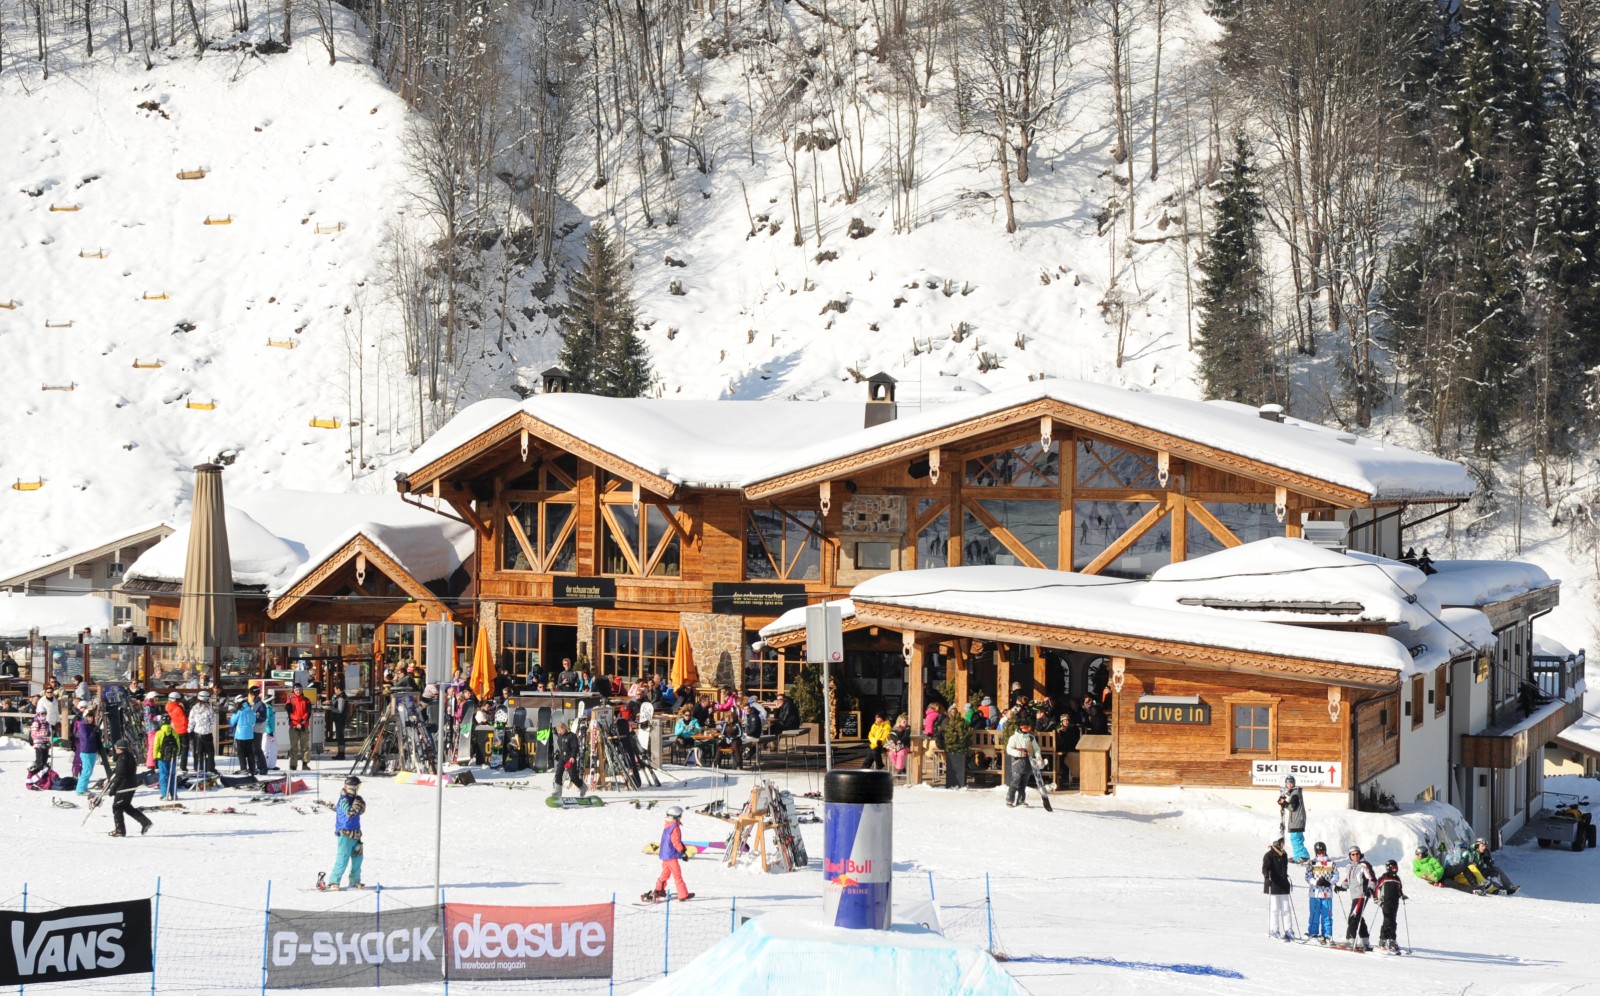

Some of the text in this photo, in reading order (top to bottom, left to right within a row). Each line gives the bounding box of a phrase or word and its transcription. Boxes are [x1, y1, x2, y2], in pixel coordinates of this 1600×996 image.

[1140, 705, 1203, 722] drive in
[1256, 764, 1278, 772] SKI
[1290, 765, 1324, 774] SOUL
[846, 859, 872, 874] Bull
[11, 911, 125, 976] VANS
[272, 926, 438, 966] G-SHOCK
[453, 913, 606, 970] pleasure
[461, 960, 526, 971] snowboard magazin
